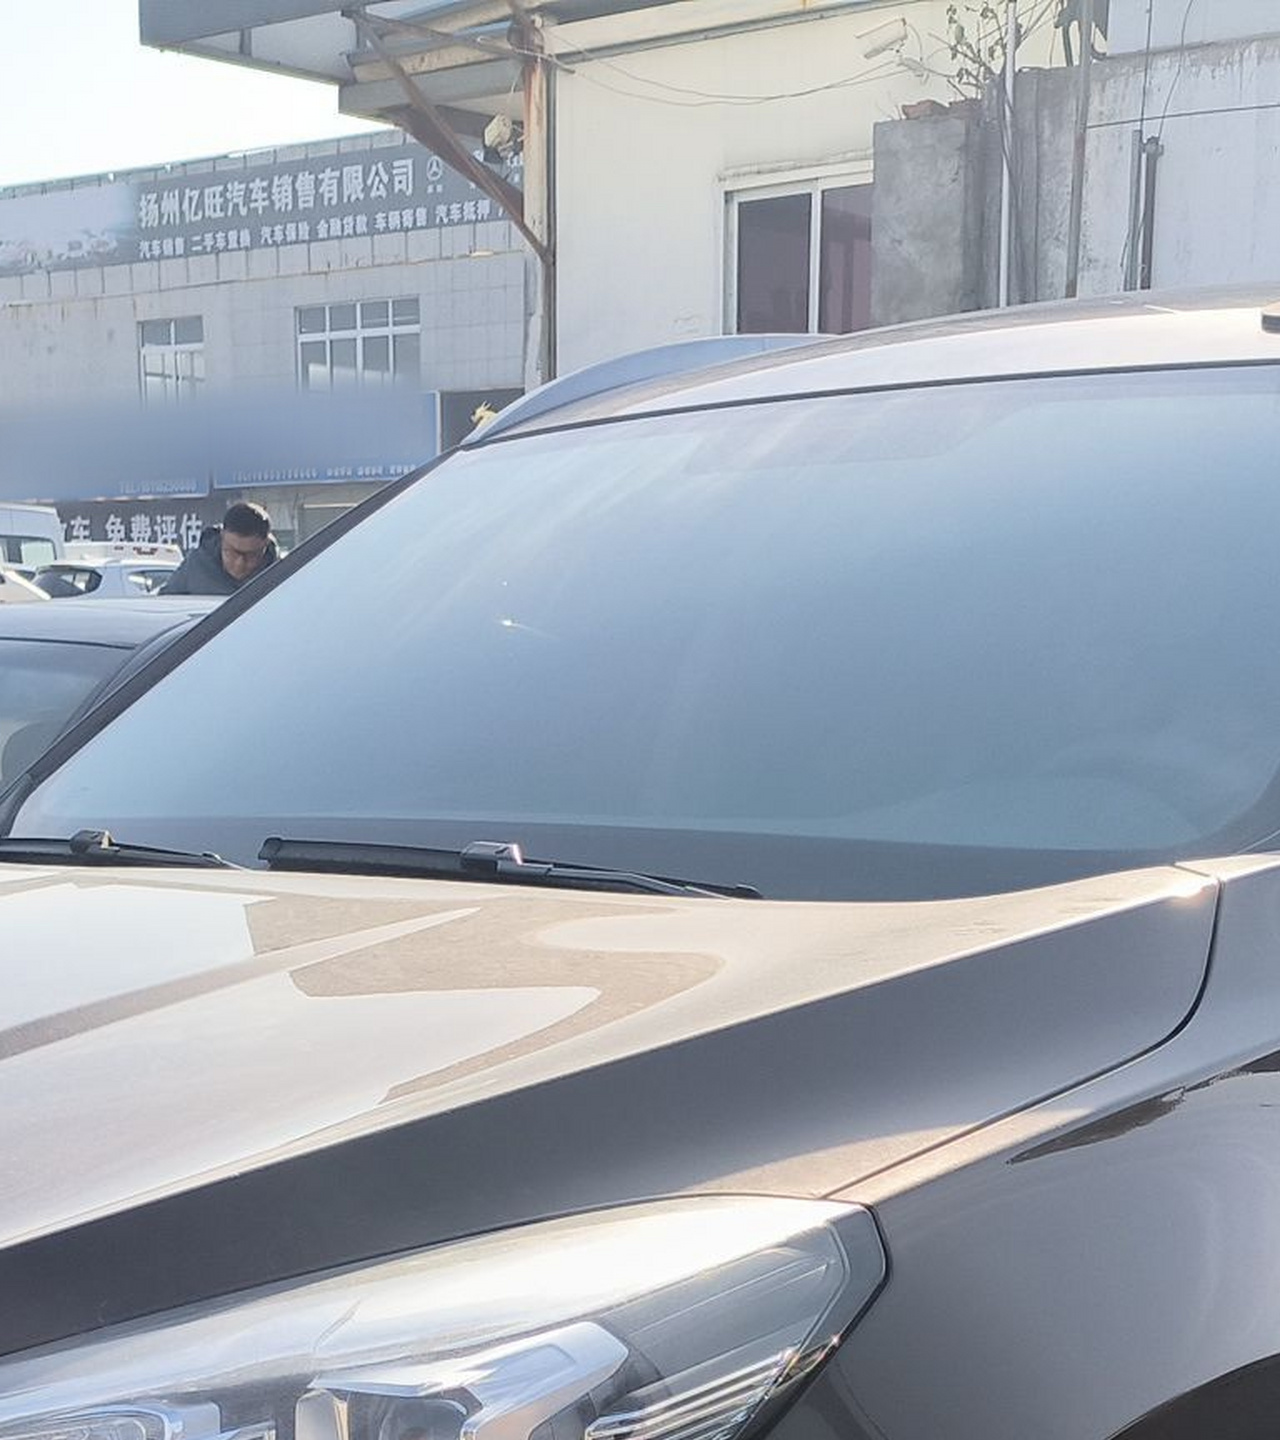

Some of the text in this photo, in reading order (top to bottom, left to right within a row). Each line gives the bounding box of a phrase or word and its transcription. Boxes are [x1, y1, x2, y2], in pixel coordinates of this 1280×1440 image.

[139, 158, 414, 229] 扬州亿旺汽车销售有限公司
[105, 513, 203, 550] 免费评估
